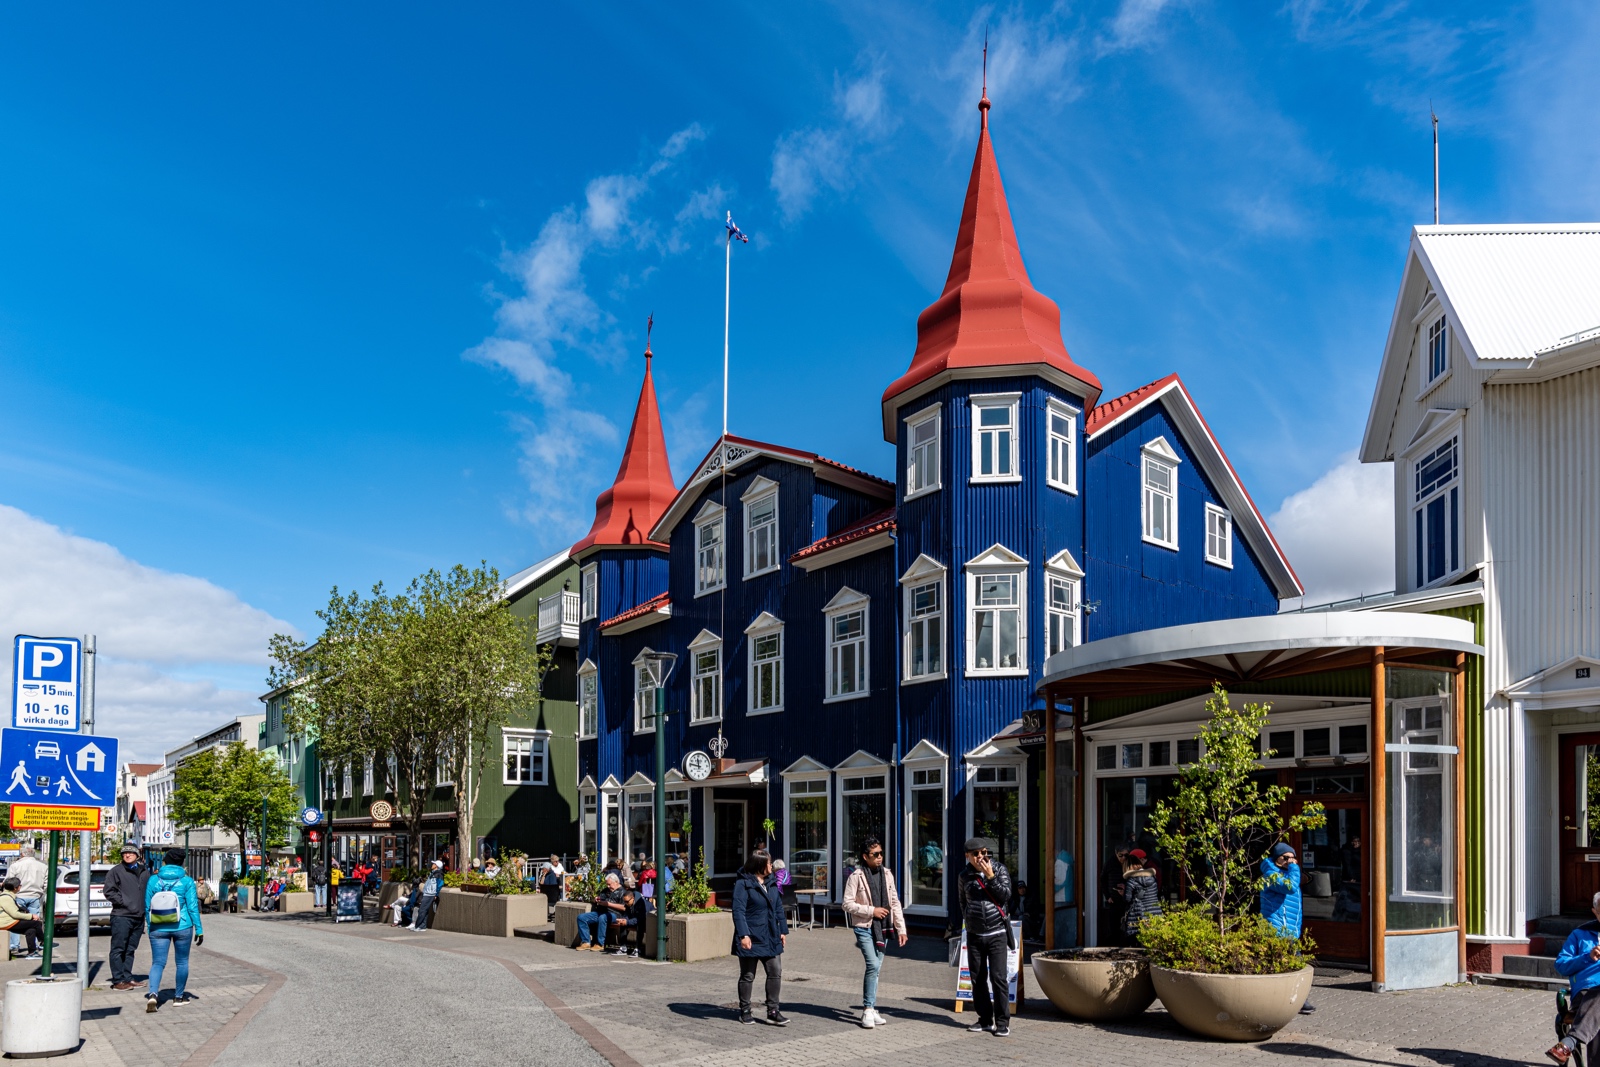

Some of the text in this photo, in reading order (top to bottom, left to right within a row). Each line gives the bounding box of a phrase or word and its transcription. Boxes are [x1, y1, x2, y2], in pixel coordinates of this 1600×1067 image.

[32, 645, 64, 678] P
[41, 684, 75, 697] 15 min.
[24, 702, 40, 714] 10
[54, 704, 69, 716] 16
[23, 716, 69, 726] virka daga
